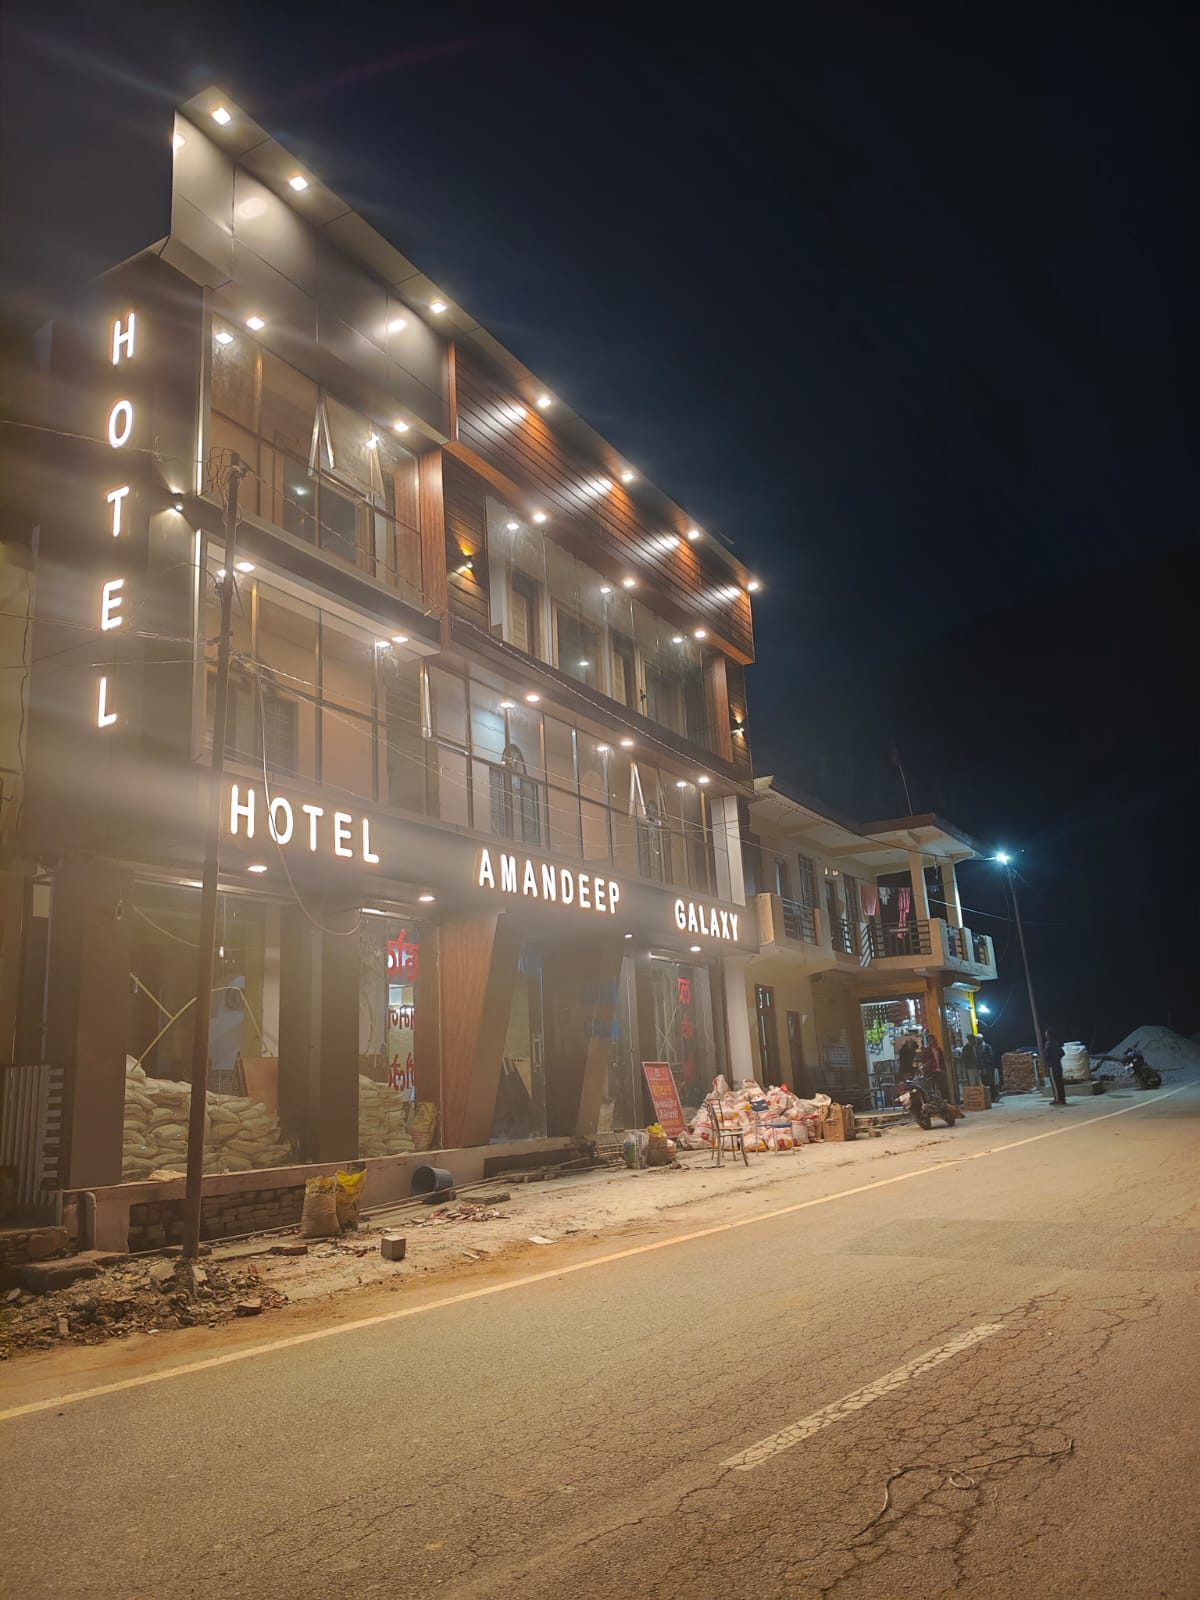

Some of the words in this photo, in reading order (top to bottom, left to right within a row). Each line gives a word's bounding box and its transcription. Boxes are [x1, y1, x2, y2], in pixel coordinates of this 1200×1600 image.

[97, 312, 136, 729] HOTEL
[230, 783, 381, 865] HOTEL
[478, 848, 620, 915] AMANDEEP
[674, 898, 739, 942] GALAXY
